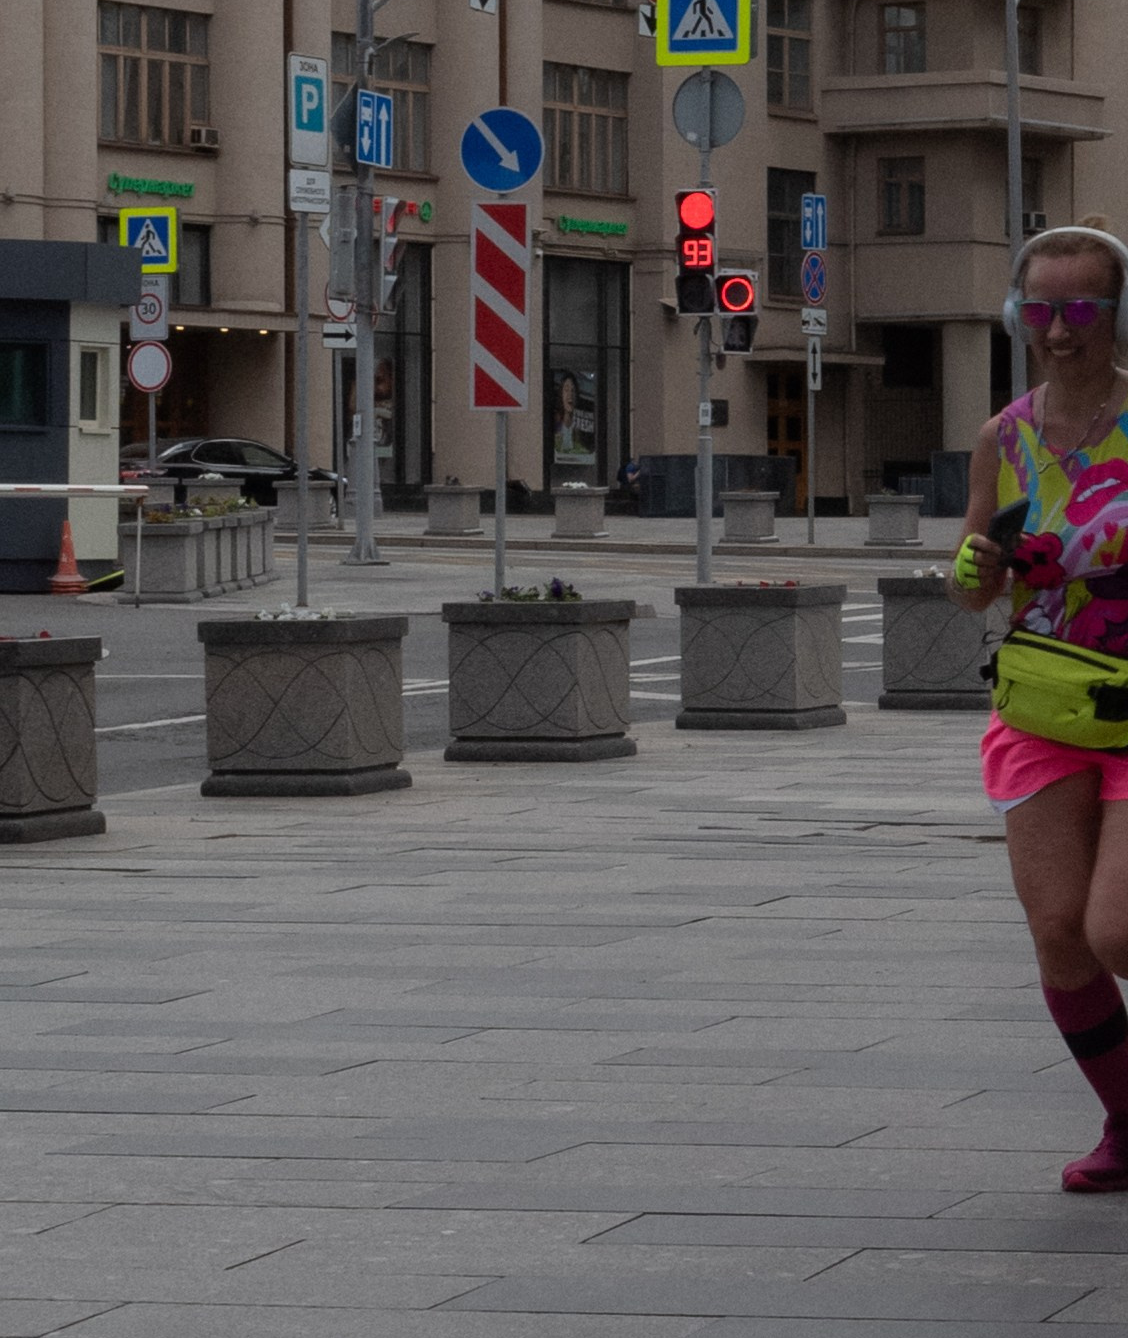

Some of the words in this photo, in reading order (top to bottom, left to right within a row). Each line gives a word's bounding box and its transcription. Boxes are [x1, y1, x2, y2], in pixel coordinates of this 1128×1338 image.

[299, 61, 319, 72] ЗОНА
[301, 83, 320, 124] P
[683, 239, 712, 266] 93
[142, 279, 160, 287] ОНА
[141, 302, 156, 315] 30
